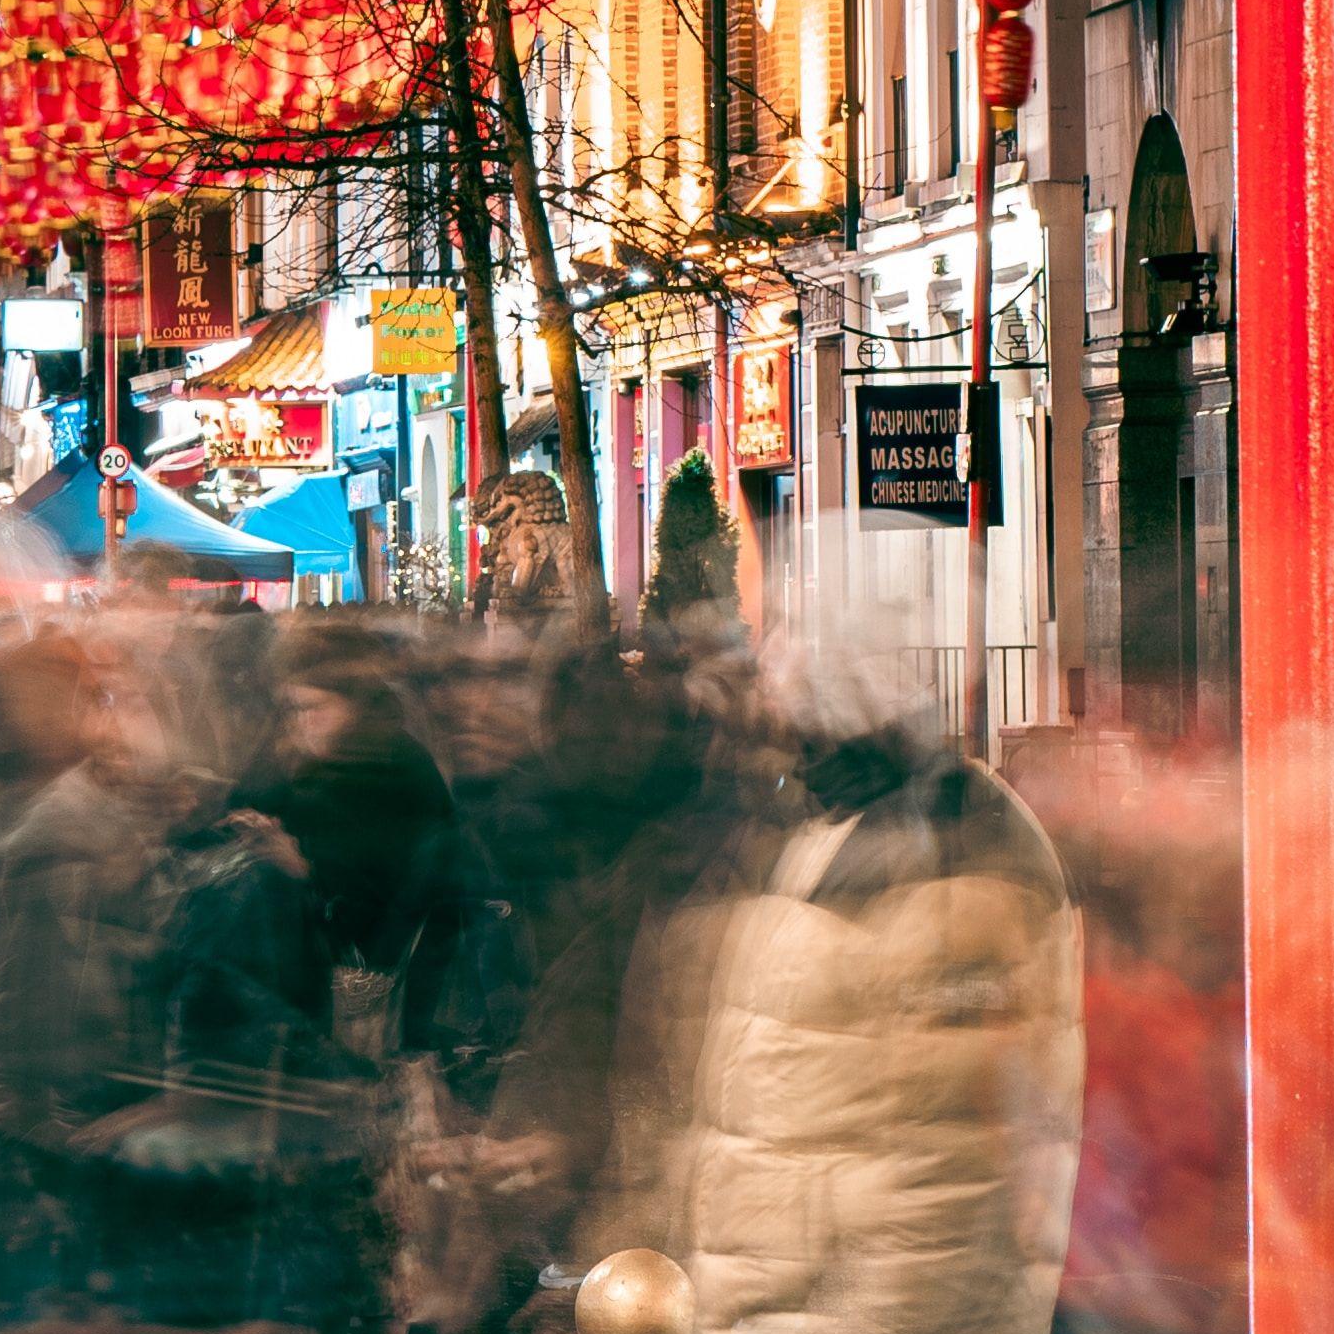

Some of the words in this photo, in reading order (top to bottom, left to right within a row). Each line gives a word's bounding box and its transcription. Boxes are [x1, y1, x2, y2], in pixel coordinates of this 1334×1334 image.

[172, 202, 210, 308] 新龍鳳
[178, 313, 211, 325] NEW
[154, 327, 191, 340] LOON
[196, 325, 232, 339] FUNG
[103, 454, 126, 468] 20
[871, 445, 954, 471] MASSAG
[871, 481, 915, 504] CHINESE
[917, 480, 966, 503] MEDICINE
